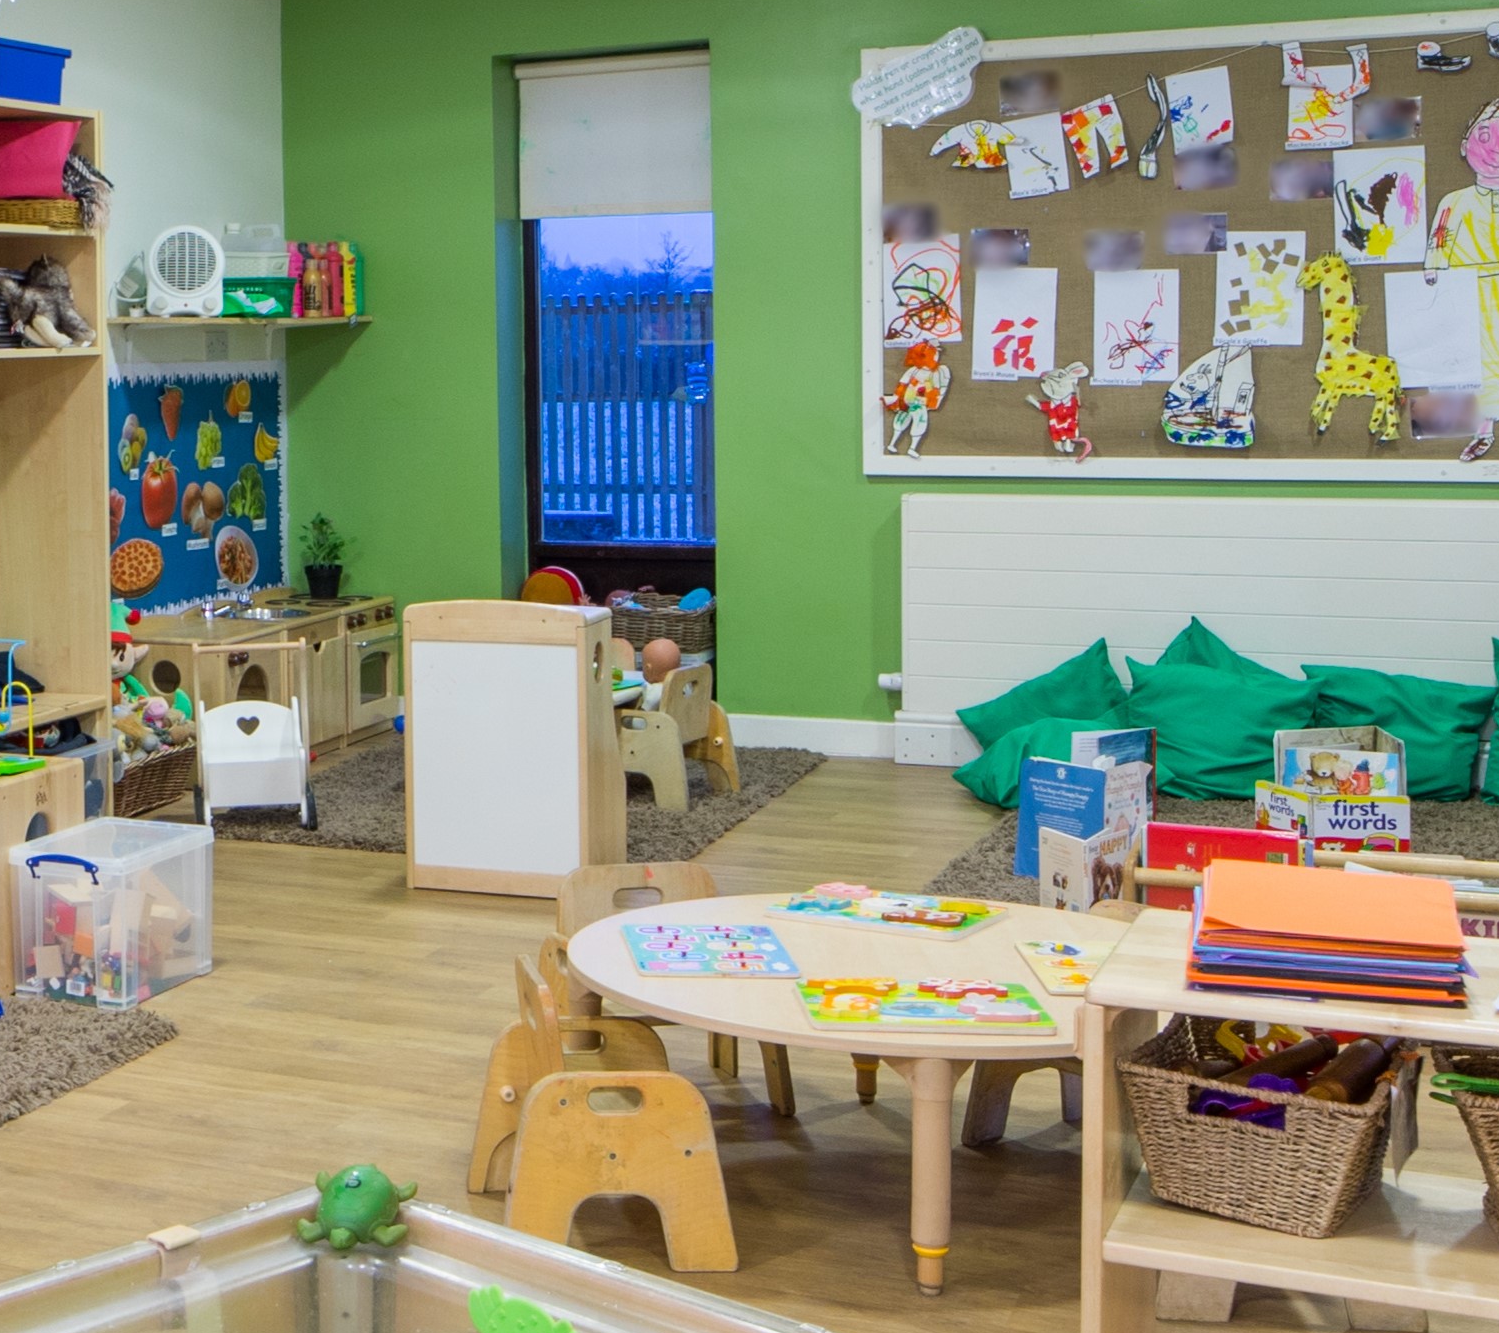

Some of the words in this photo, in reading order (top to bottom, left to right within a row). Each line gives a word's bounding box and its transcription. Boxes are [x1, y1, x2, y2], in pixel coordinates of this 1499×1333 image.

[965, 38, 980, 51] and
[958, 54, 977, 68] with
[1458, 382, 1481, 390] Letter
[1270, 792, 1288, 806] first
[1268, 802, 1295, 817] words
[1333, 800, 1379, 816] first
[1328, 814, 1397, 830] words
[1101, 835, 1127, 856] HAPPY
